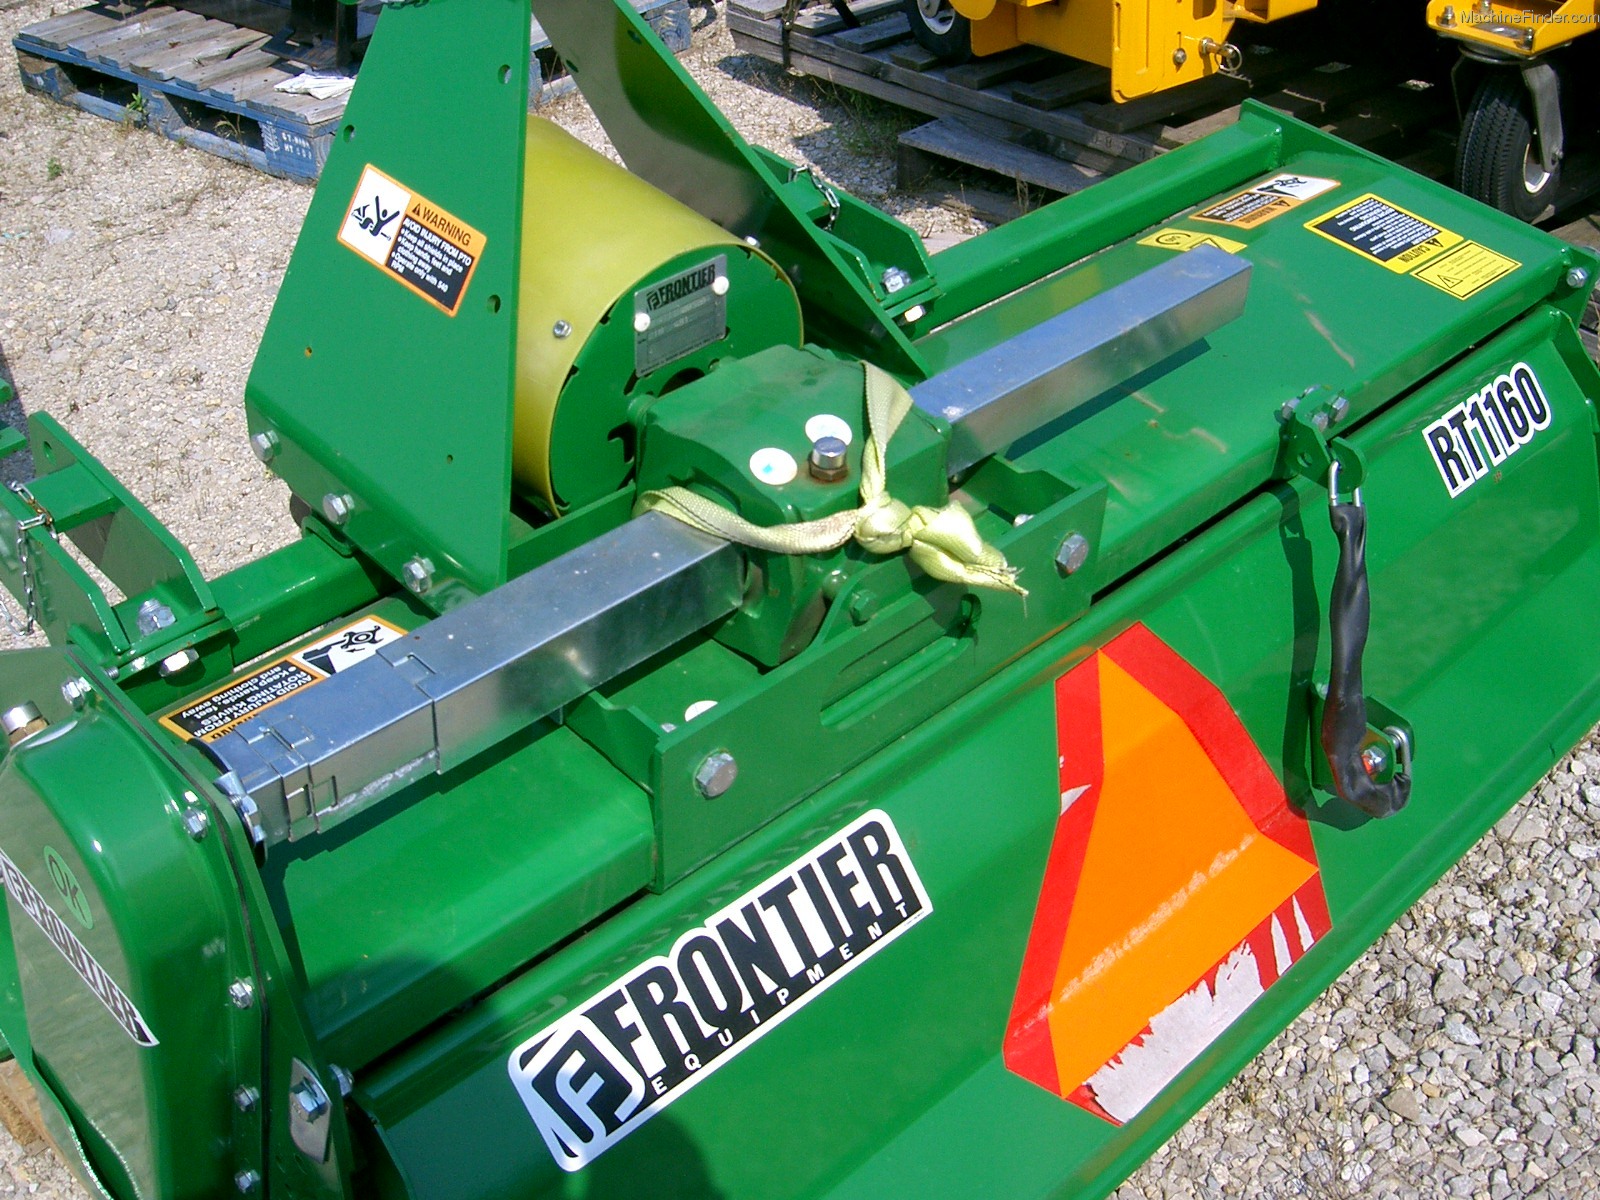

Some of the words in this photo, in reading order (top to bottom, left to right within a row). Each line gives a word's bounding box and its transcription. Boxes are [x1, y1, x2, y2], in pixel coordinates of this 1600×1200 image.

[423, 206, 472, 247] WARNING
[403, 217, 421, 234] AVOID
[420, 227, 442, 247] INJURY
[440, 240, 459, 259] FROM
[458, 252, 472, 267] PTO
[1398, 245, 1430, 263] CAUTION
[390, 260, 405, 273] RPM
[395, 253, 415, 270] Operate
[414, 266, 426, 280] only
[437, 280, 449, 293] 540
[418, 258, 433, 273] away
[441, 264, 453, 276] and
[448, 258, 464, 274] place
[658, 264, 716, 306] FRONTIER
[1427, 367, 1547, 491] RT1160
[258, 670, 289, 687] Keep
[259, 666, 282, 679] and
[211, 678, 259, 703] clothing
[246, 671, 307, 702] ROTATING
[276, 675, 312, 696] AVOID
[182, 701, 212, 719] away
[194, 705, 218, 719] feet
[201, 701, 247, 726] KNIVES
[233, 694, 276, 718] INJURY
[194, 716, 232, 737] FROM
[49, 854, 88, 923] OK
[20, 874, 139, 1040] FRONTIER
[582, 820, 920, 1082] FRONTIER
[651, 902, 910, 1096] EQUIPMENT
